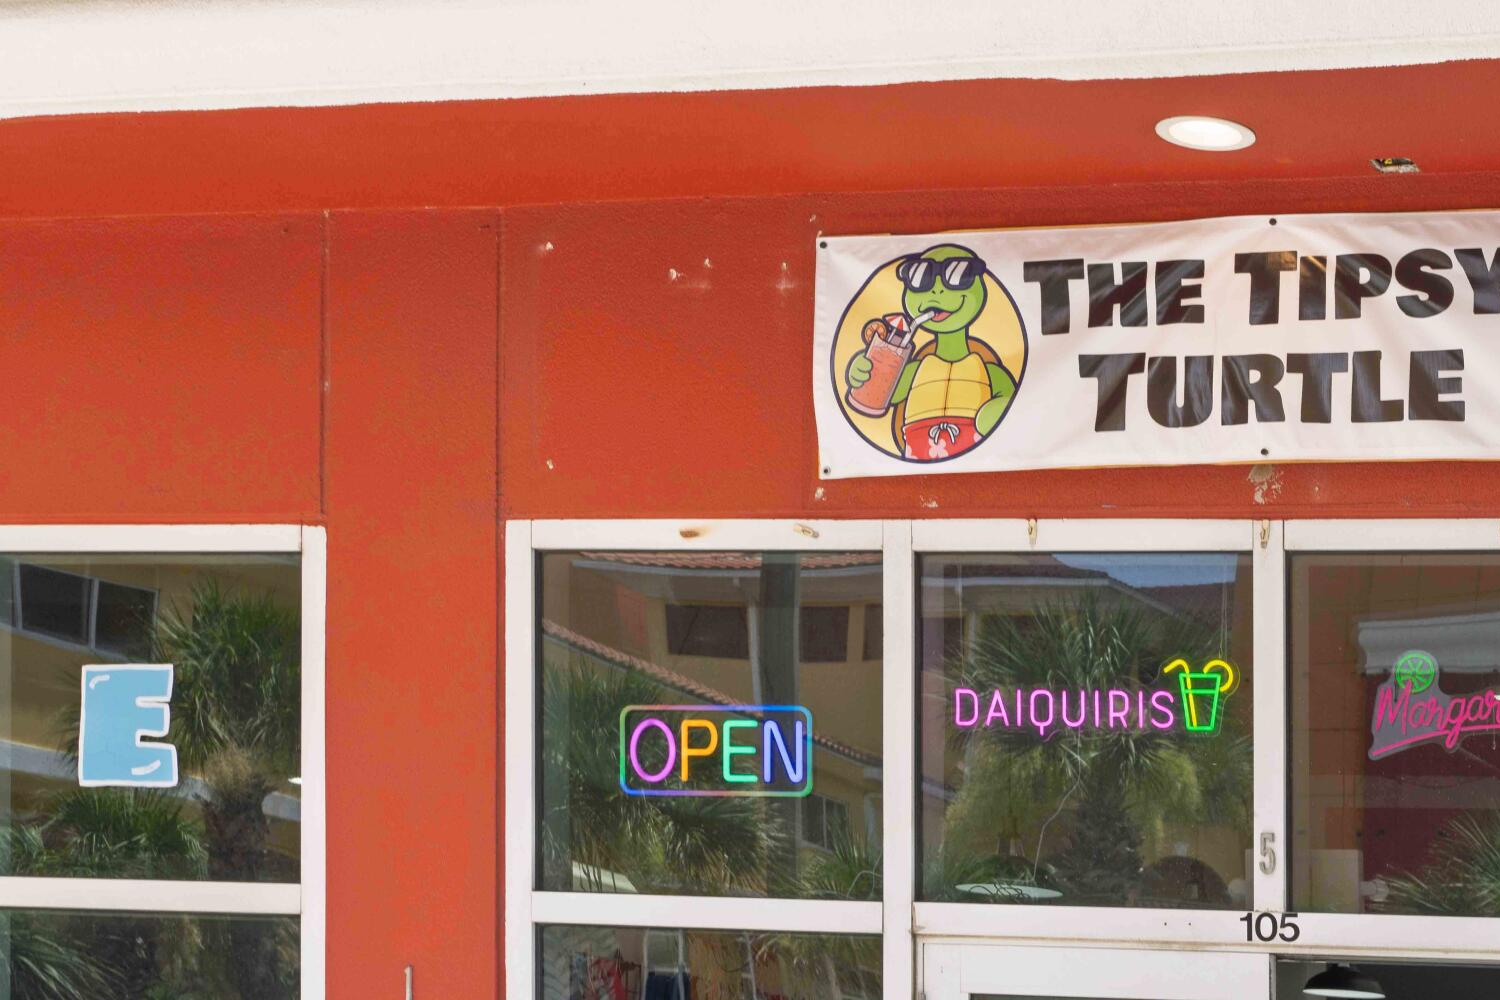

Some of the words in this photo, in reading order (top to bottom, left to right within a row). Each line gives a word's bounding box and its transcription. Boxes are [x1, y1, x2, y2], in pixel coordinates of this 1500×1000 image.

[1022, 257, 1205, 336] THE
[1077, 348, 1467, 432] TURTLE
[954, 687, 1176, 735] DAIQUIRIS
[629, 717, 804, 784] OPEN
[1257, 831, 1277, 876] 5
[1239, 911, 1301, 943] 105
